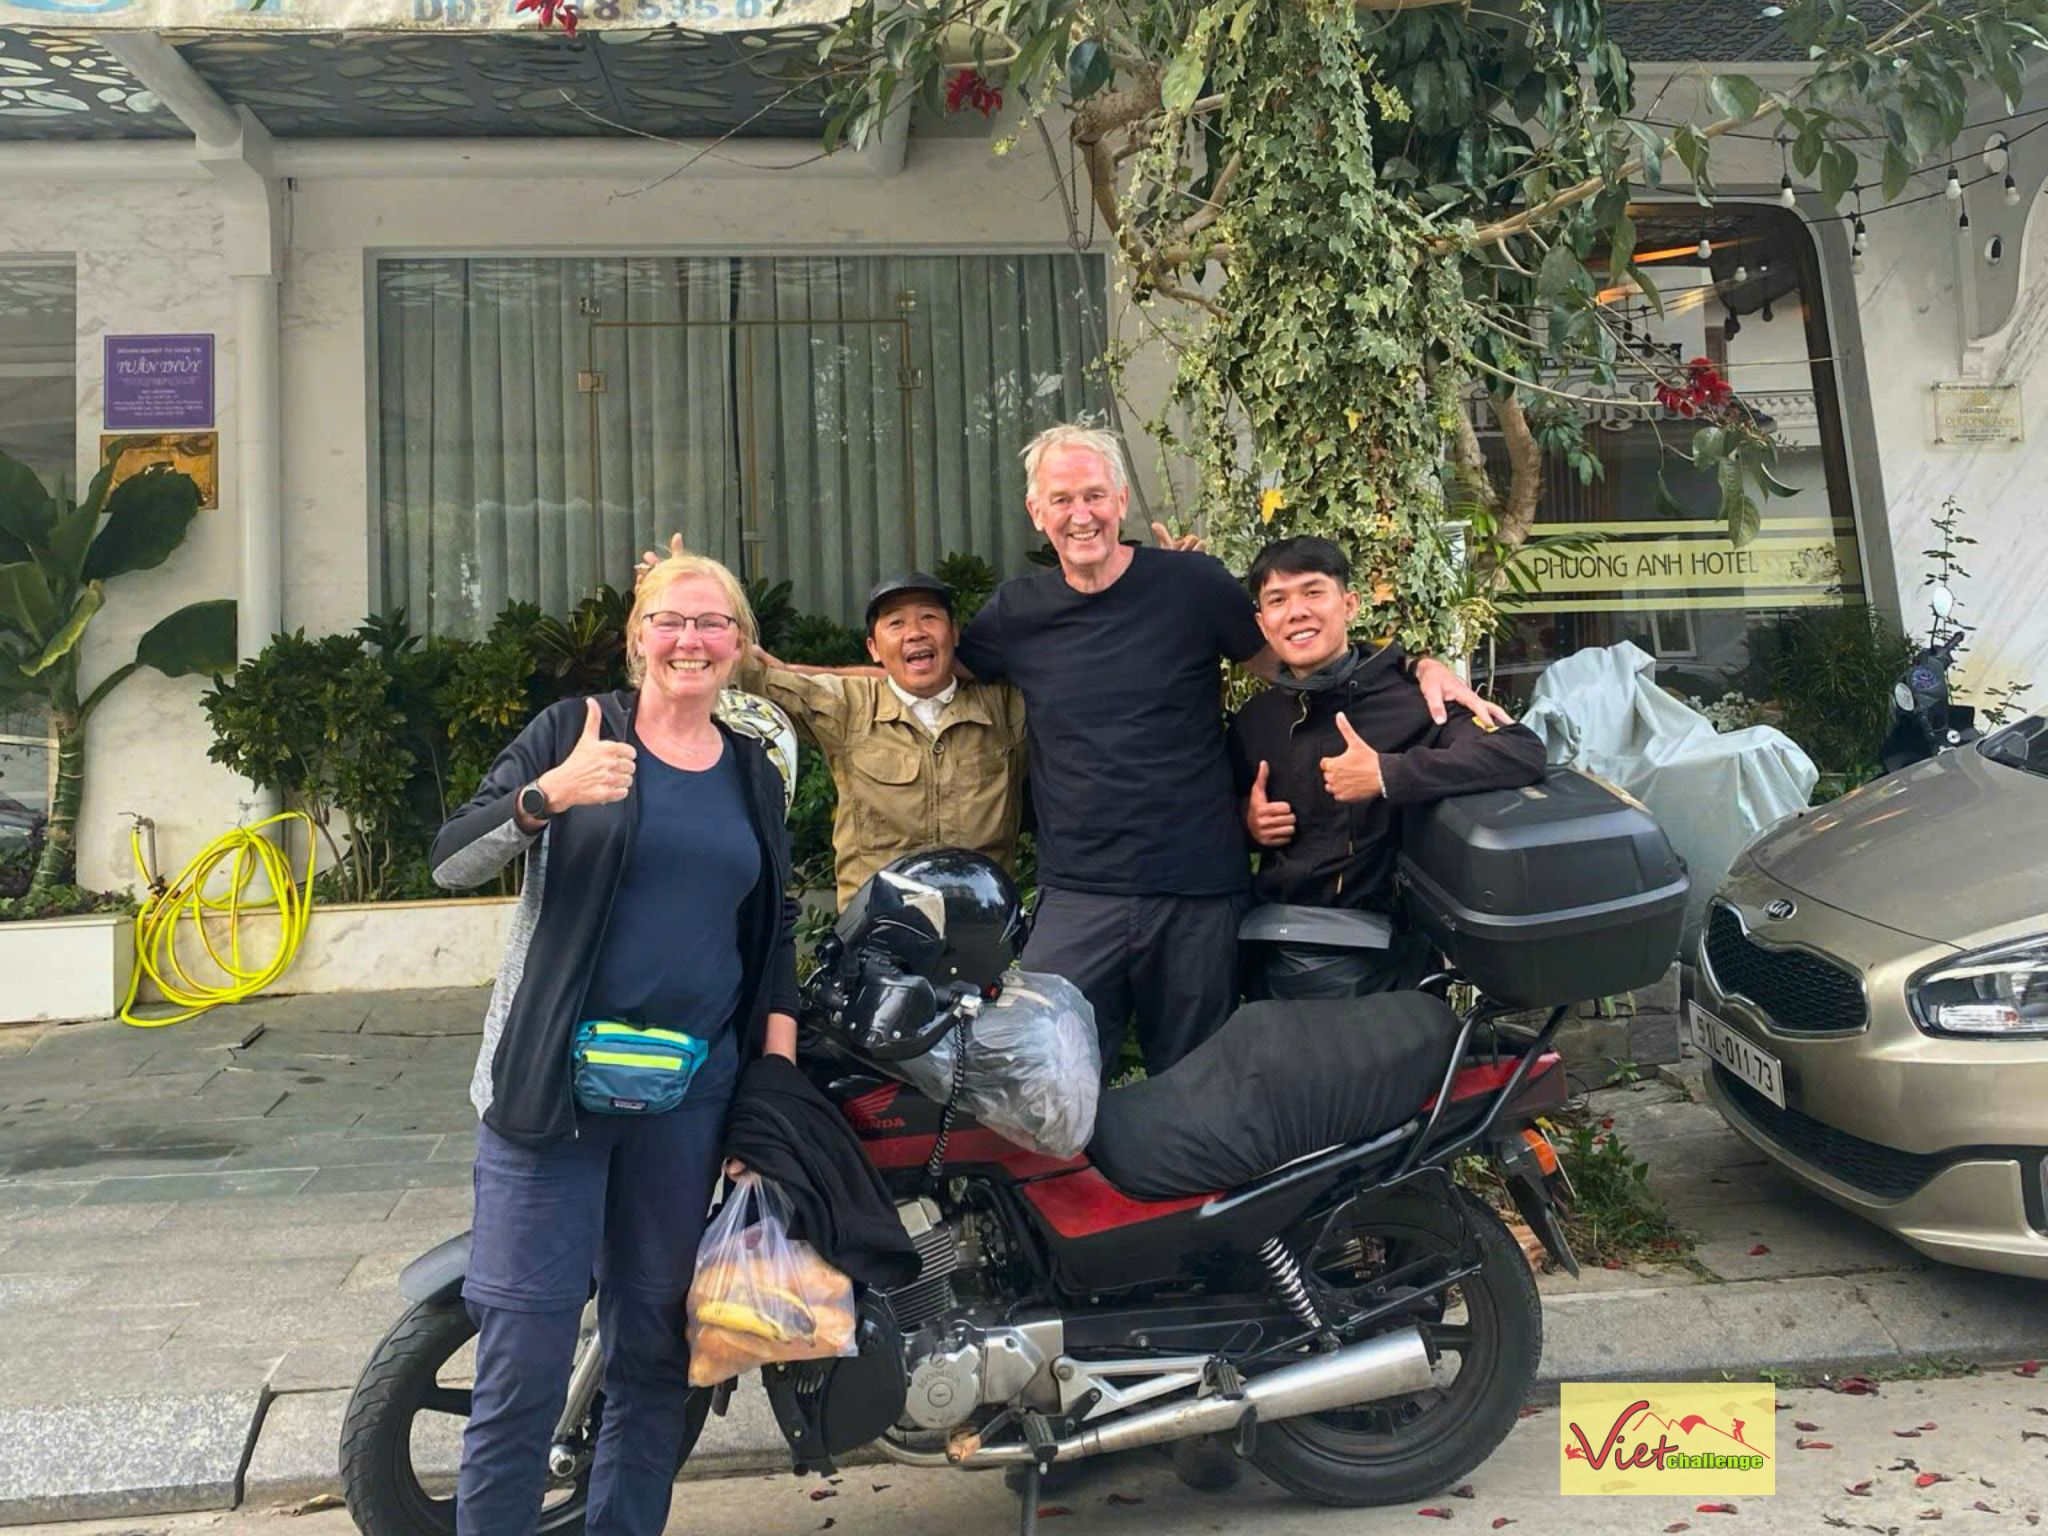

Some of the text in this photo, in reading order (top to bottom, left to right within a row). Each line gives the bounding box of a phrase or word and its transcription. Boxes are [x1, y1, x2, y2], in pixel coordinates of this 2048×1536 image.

[1533, 550, 1759, 579] PHUONG ANH HOTEL
[1696, 1016, 1774, 1092] 51L-011.73
[850, 1116, 907, 1131] ONDA
